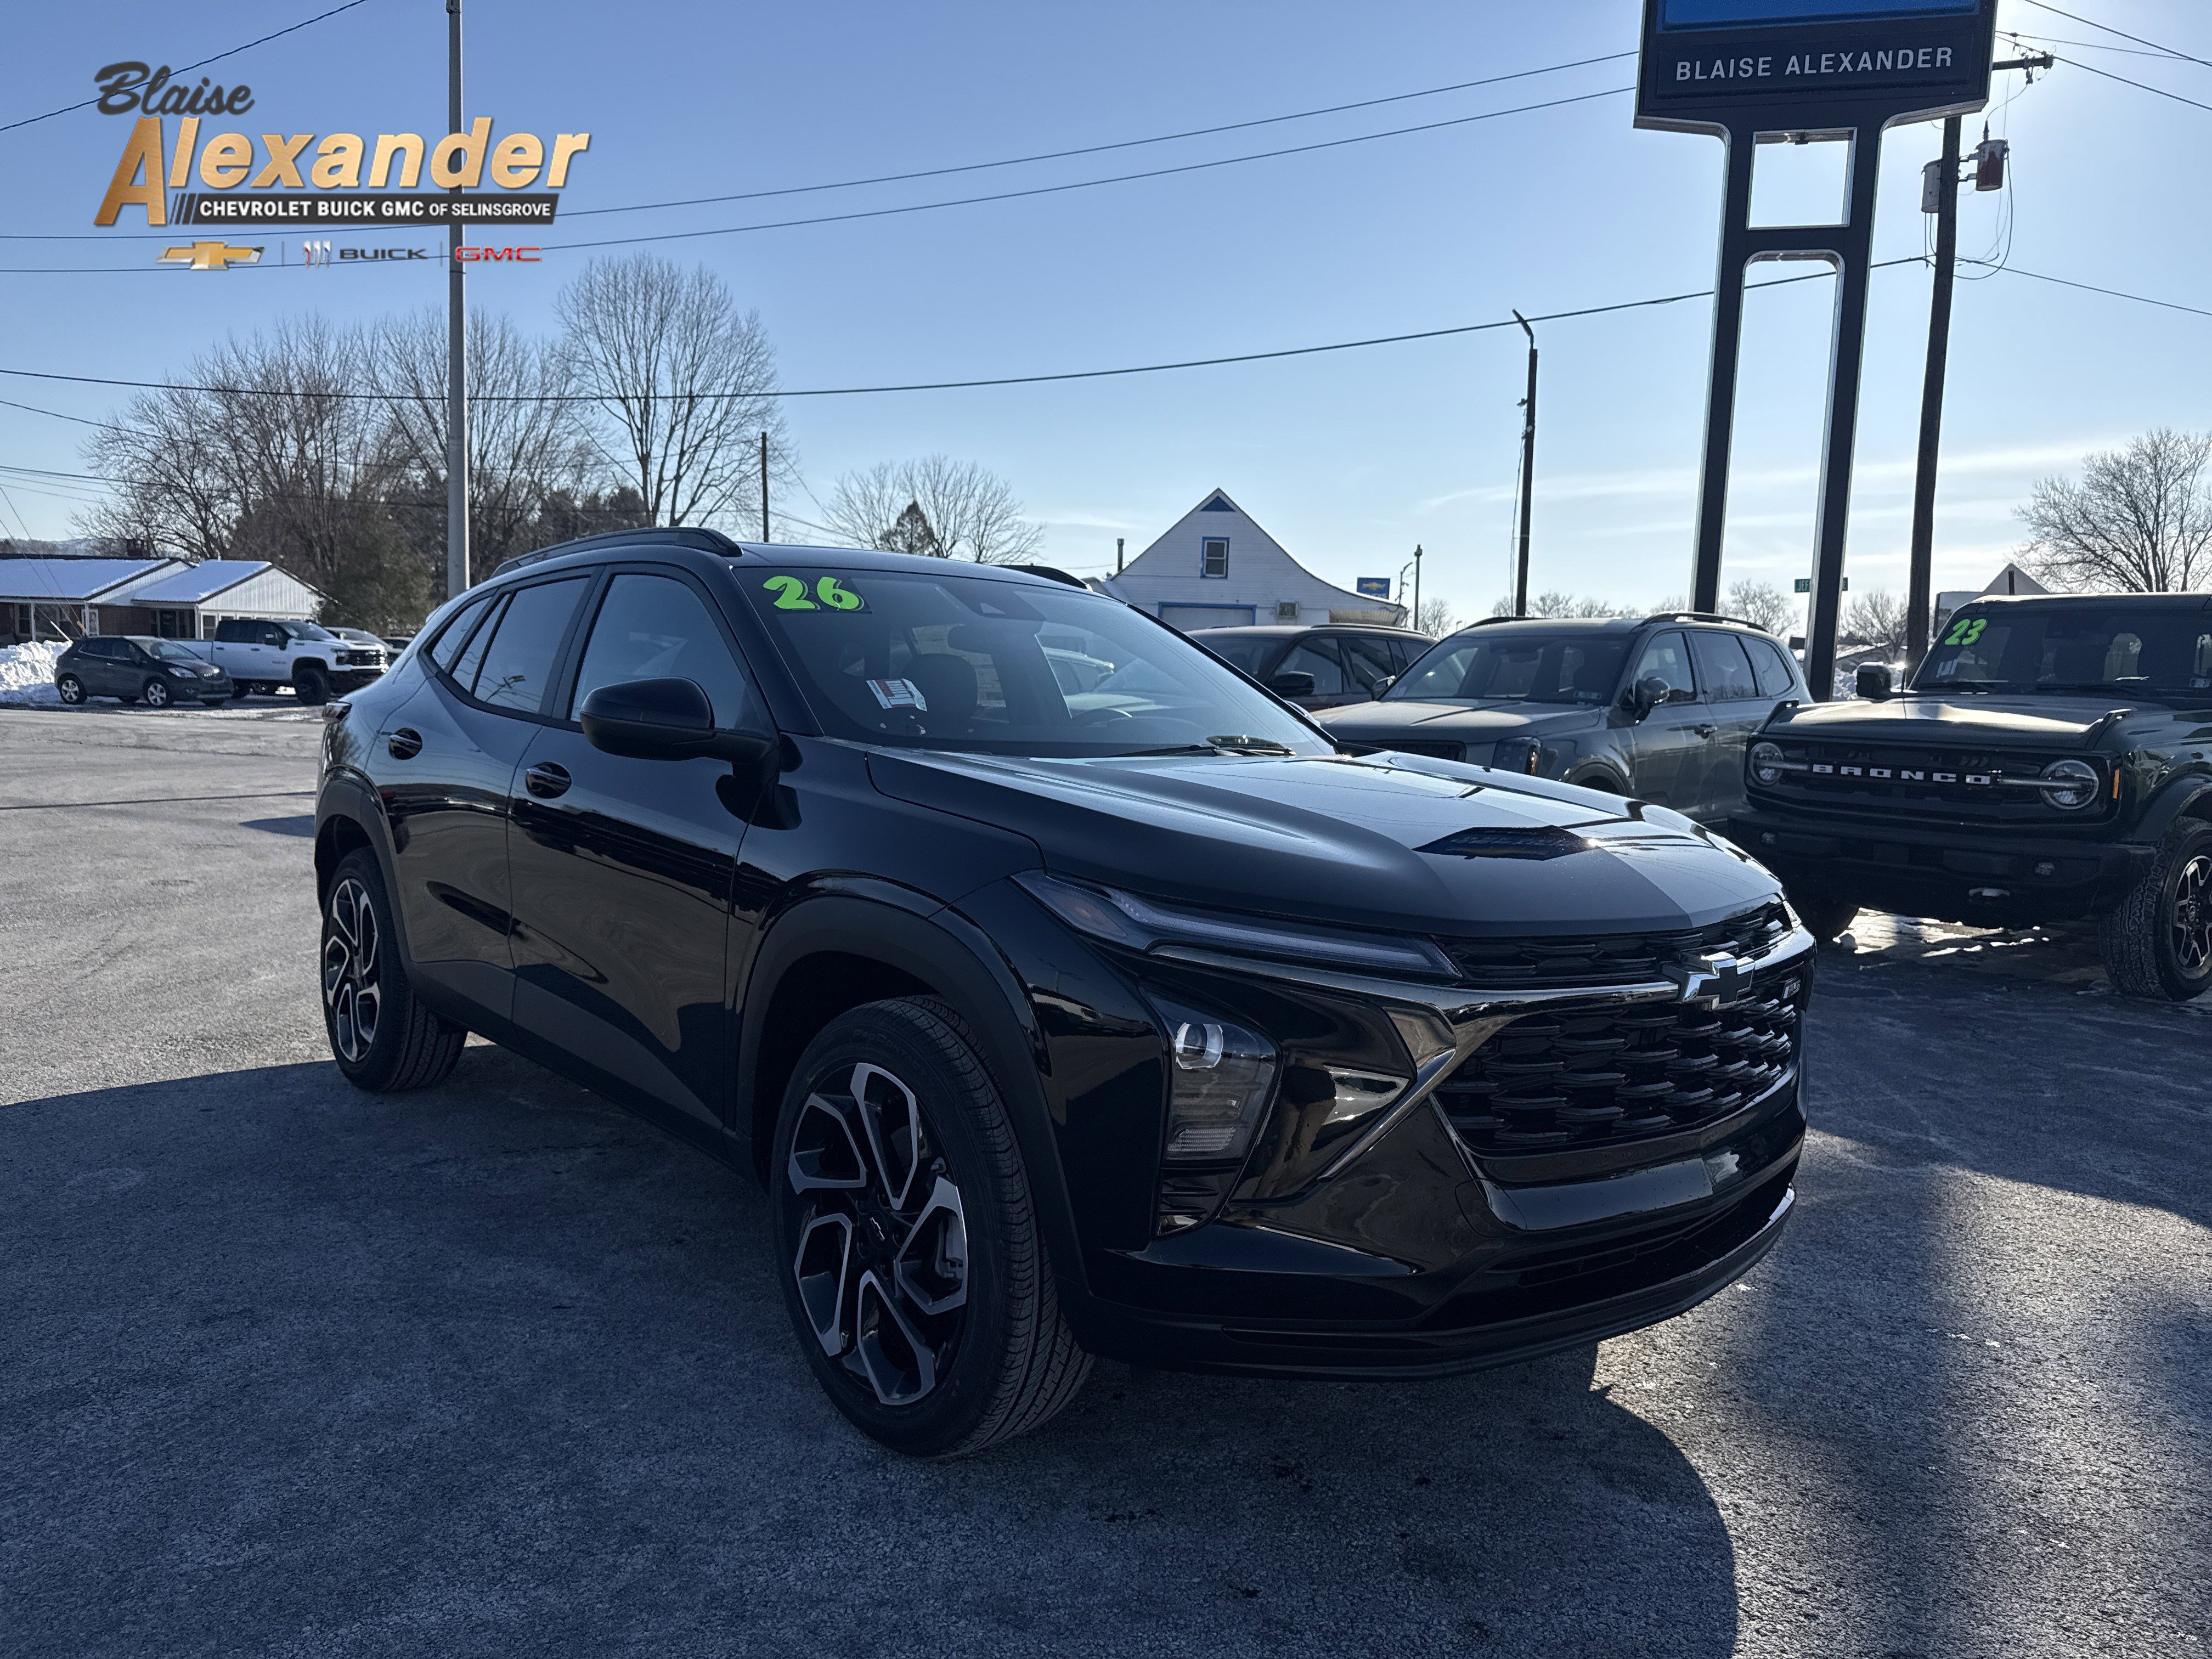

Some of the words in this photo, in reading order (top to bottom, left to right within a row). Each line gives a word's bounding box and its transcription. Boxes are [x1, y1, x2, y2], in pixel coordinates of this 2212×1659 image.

[1675, 56, 1773, 81] BLAISE
[1785, 47, 1953, 75] ALEXANDER
[763, 575, 865, 611] 26
[1944, 618, 1988, 646] 23
[1812, 763, 1991, 785] BRONCO
